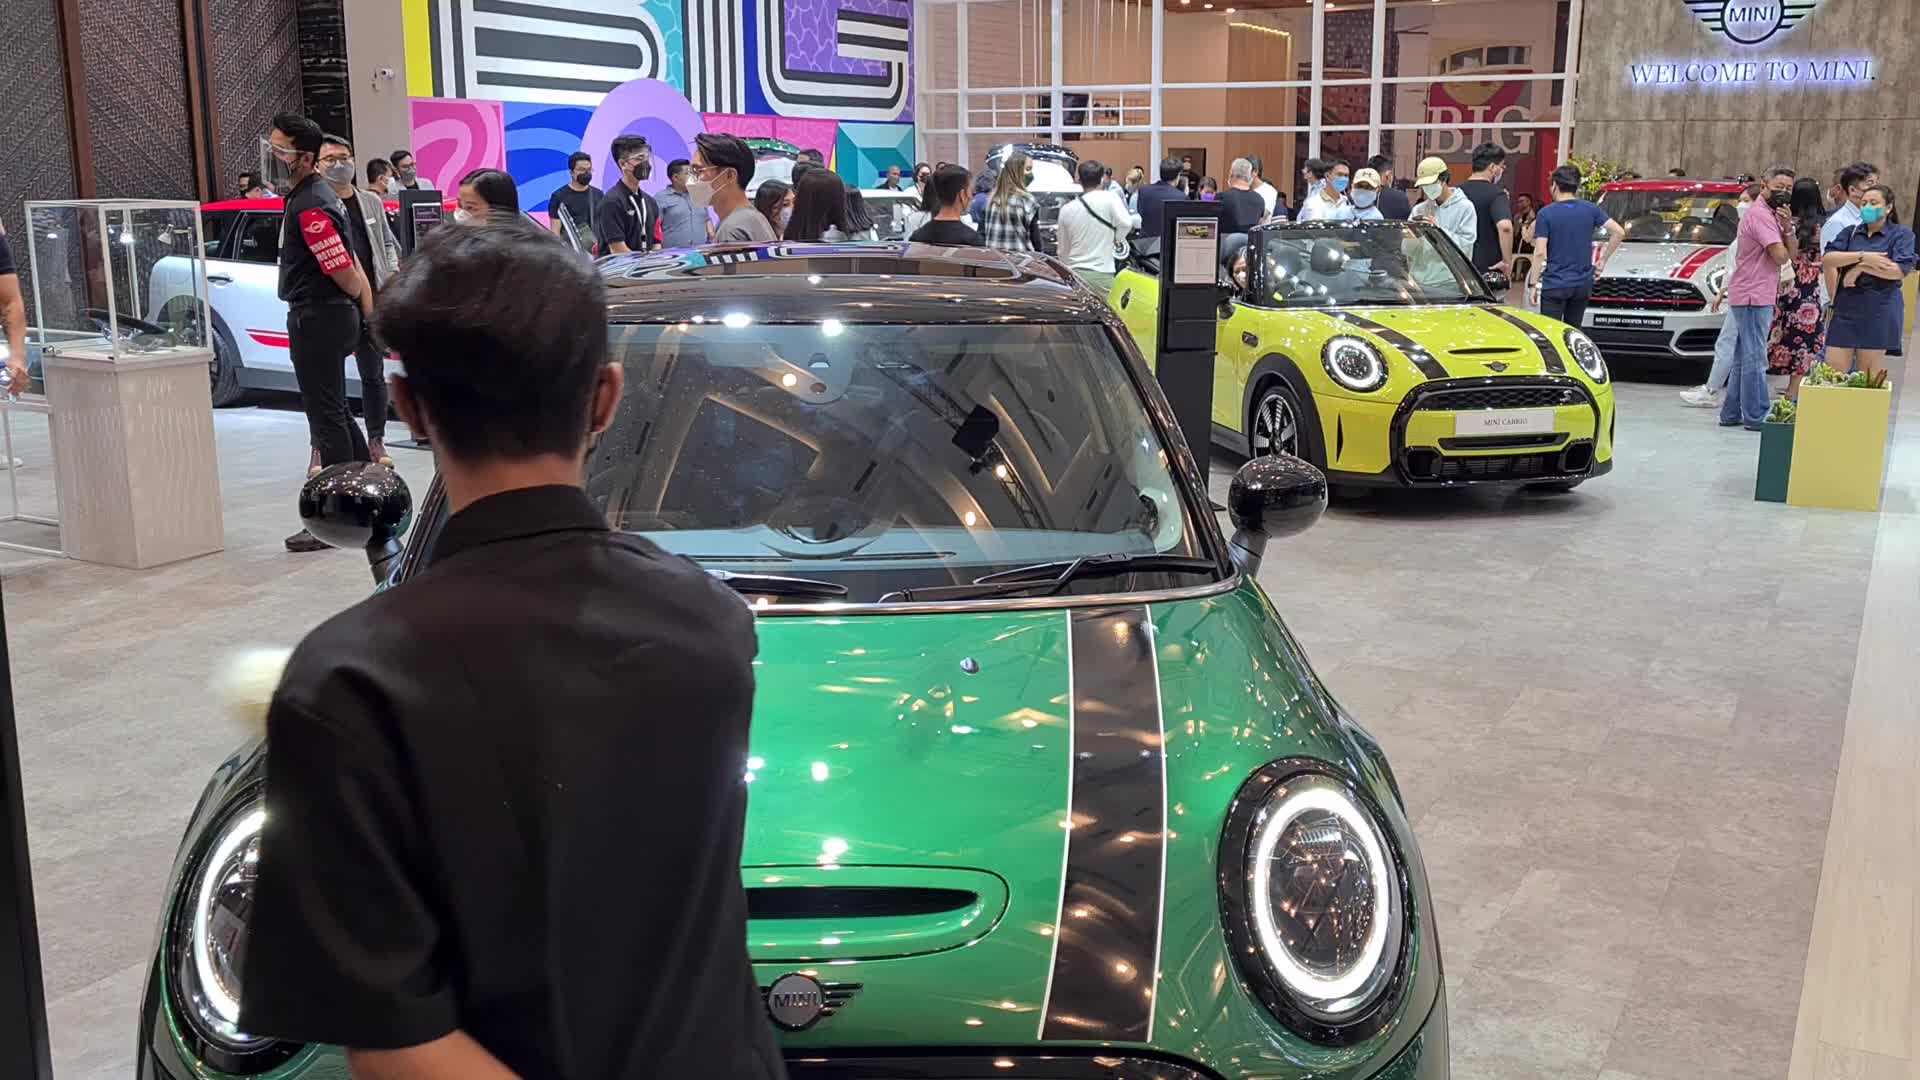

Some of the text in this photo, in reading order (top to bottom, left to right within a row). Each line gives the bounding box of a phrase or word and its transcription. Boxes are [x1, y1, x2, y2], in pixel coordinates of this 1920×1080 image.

[1728, 6, 1775, 23] MINI
[1630, 59, 1876, 85] WELCOME TO MINI.
[1425, 105, 1535, 155] BIG
[1484, 418, 1501, 426] MINI
[773, 992, 817, 1008] MINI
